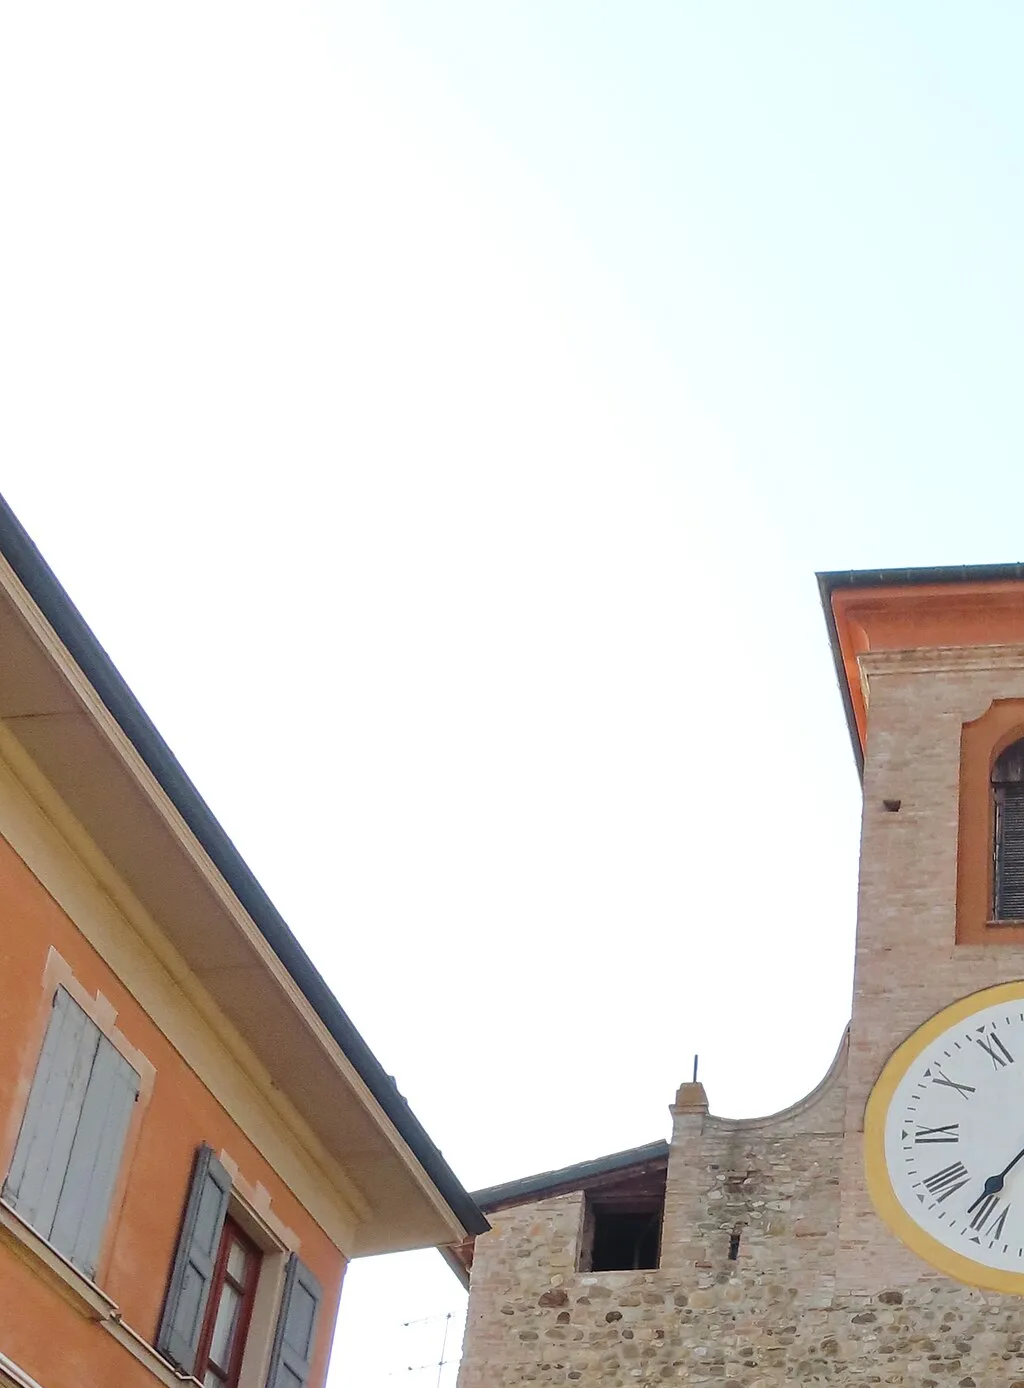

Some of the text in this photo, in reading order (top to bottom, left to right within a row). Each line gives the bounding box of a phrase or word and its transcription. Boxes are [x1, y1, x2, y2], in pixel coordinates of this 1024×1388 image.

[976, 1032, 1014, 1071] XI
[932, 1071, 976, 1100] X
[915, 1123, 959, 1143] IX
[922, 1161, 973, 1203] VIII
[969, 1194, 1011, 1240] VII
